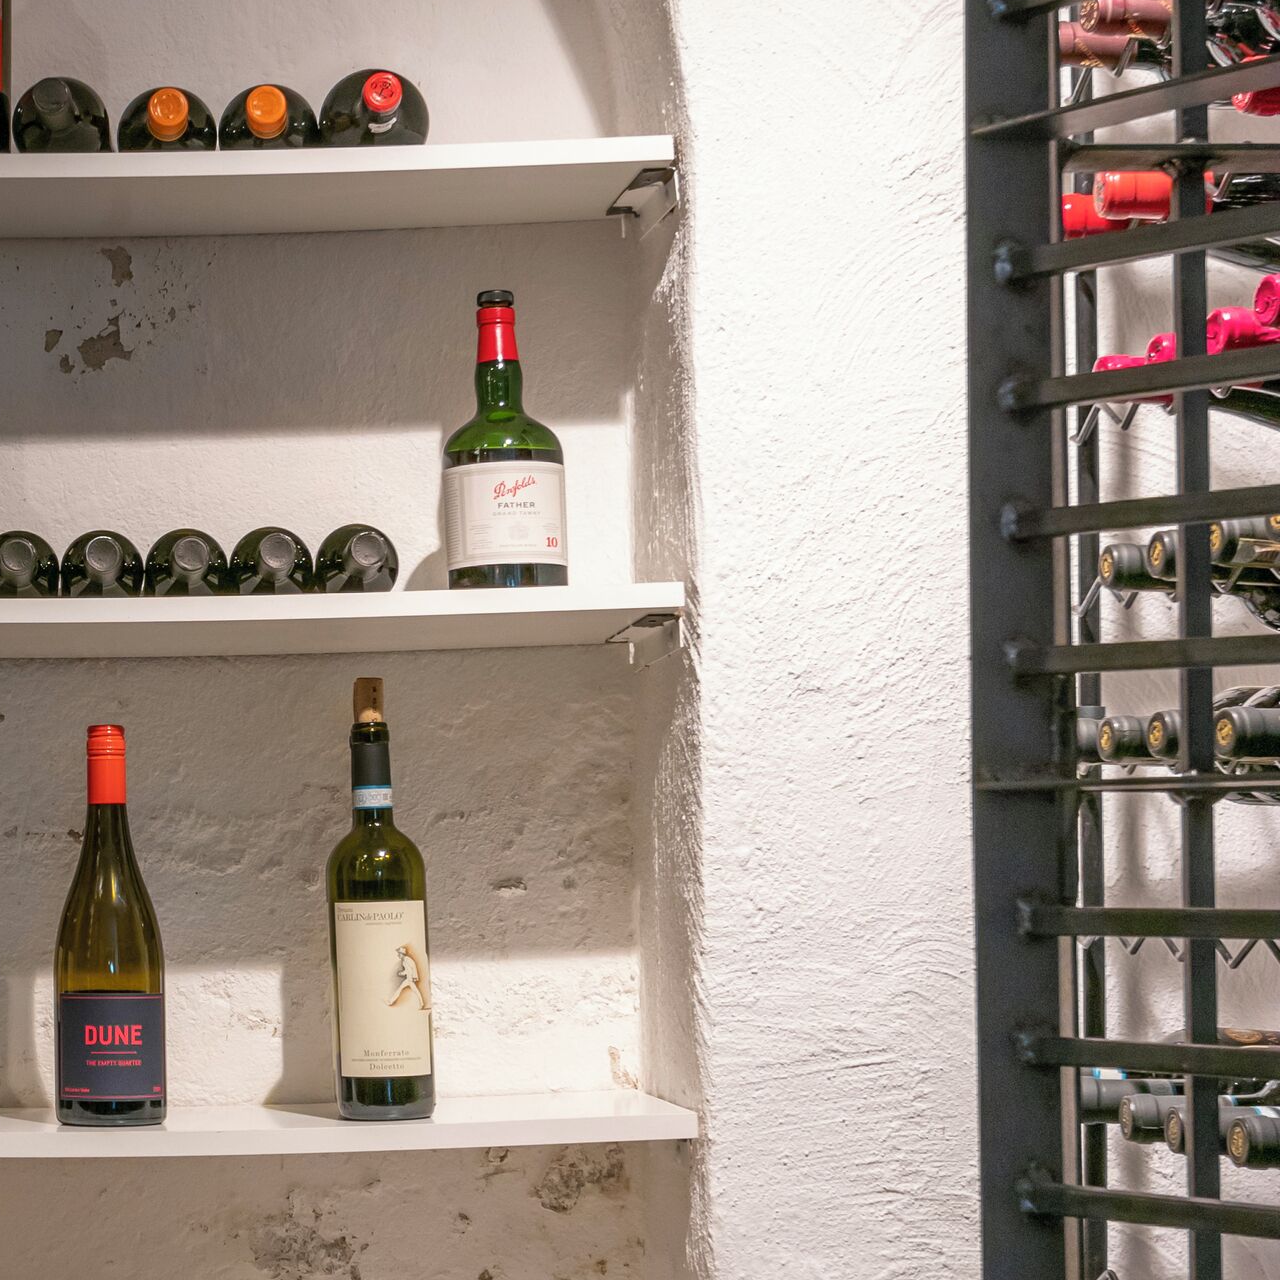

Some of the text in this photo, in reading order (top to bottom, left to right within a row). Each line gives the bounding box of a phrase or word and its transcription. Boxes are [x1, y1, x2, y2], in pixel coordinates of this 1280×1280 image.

[493, 474, 537, 500] Penfolds
[497, 501, 535, 509] FATHER
[546, 536, 558, 548] 10
[84, 1024, 143, 1046] DUNE
[363, 1048, 410, 1057] Monferrato
[369, 1062, 405, 1070] Dolcetto
